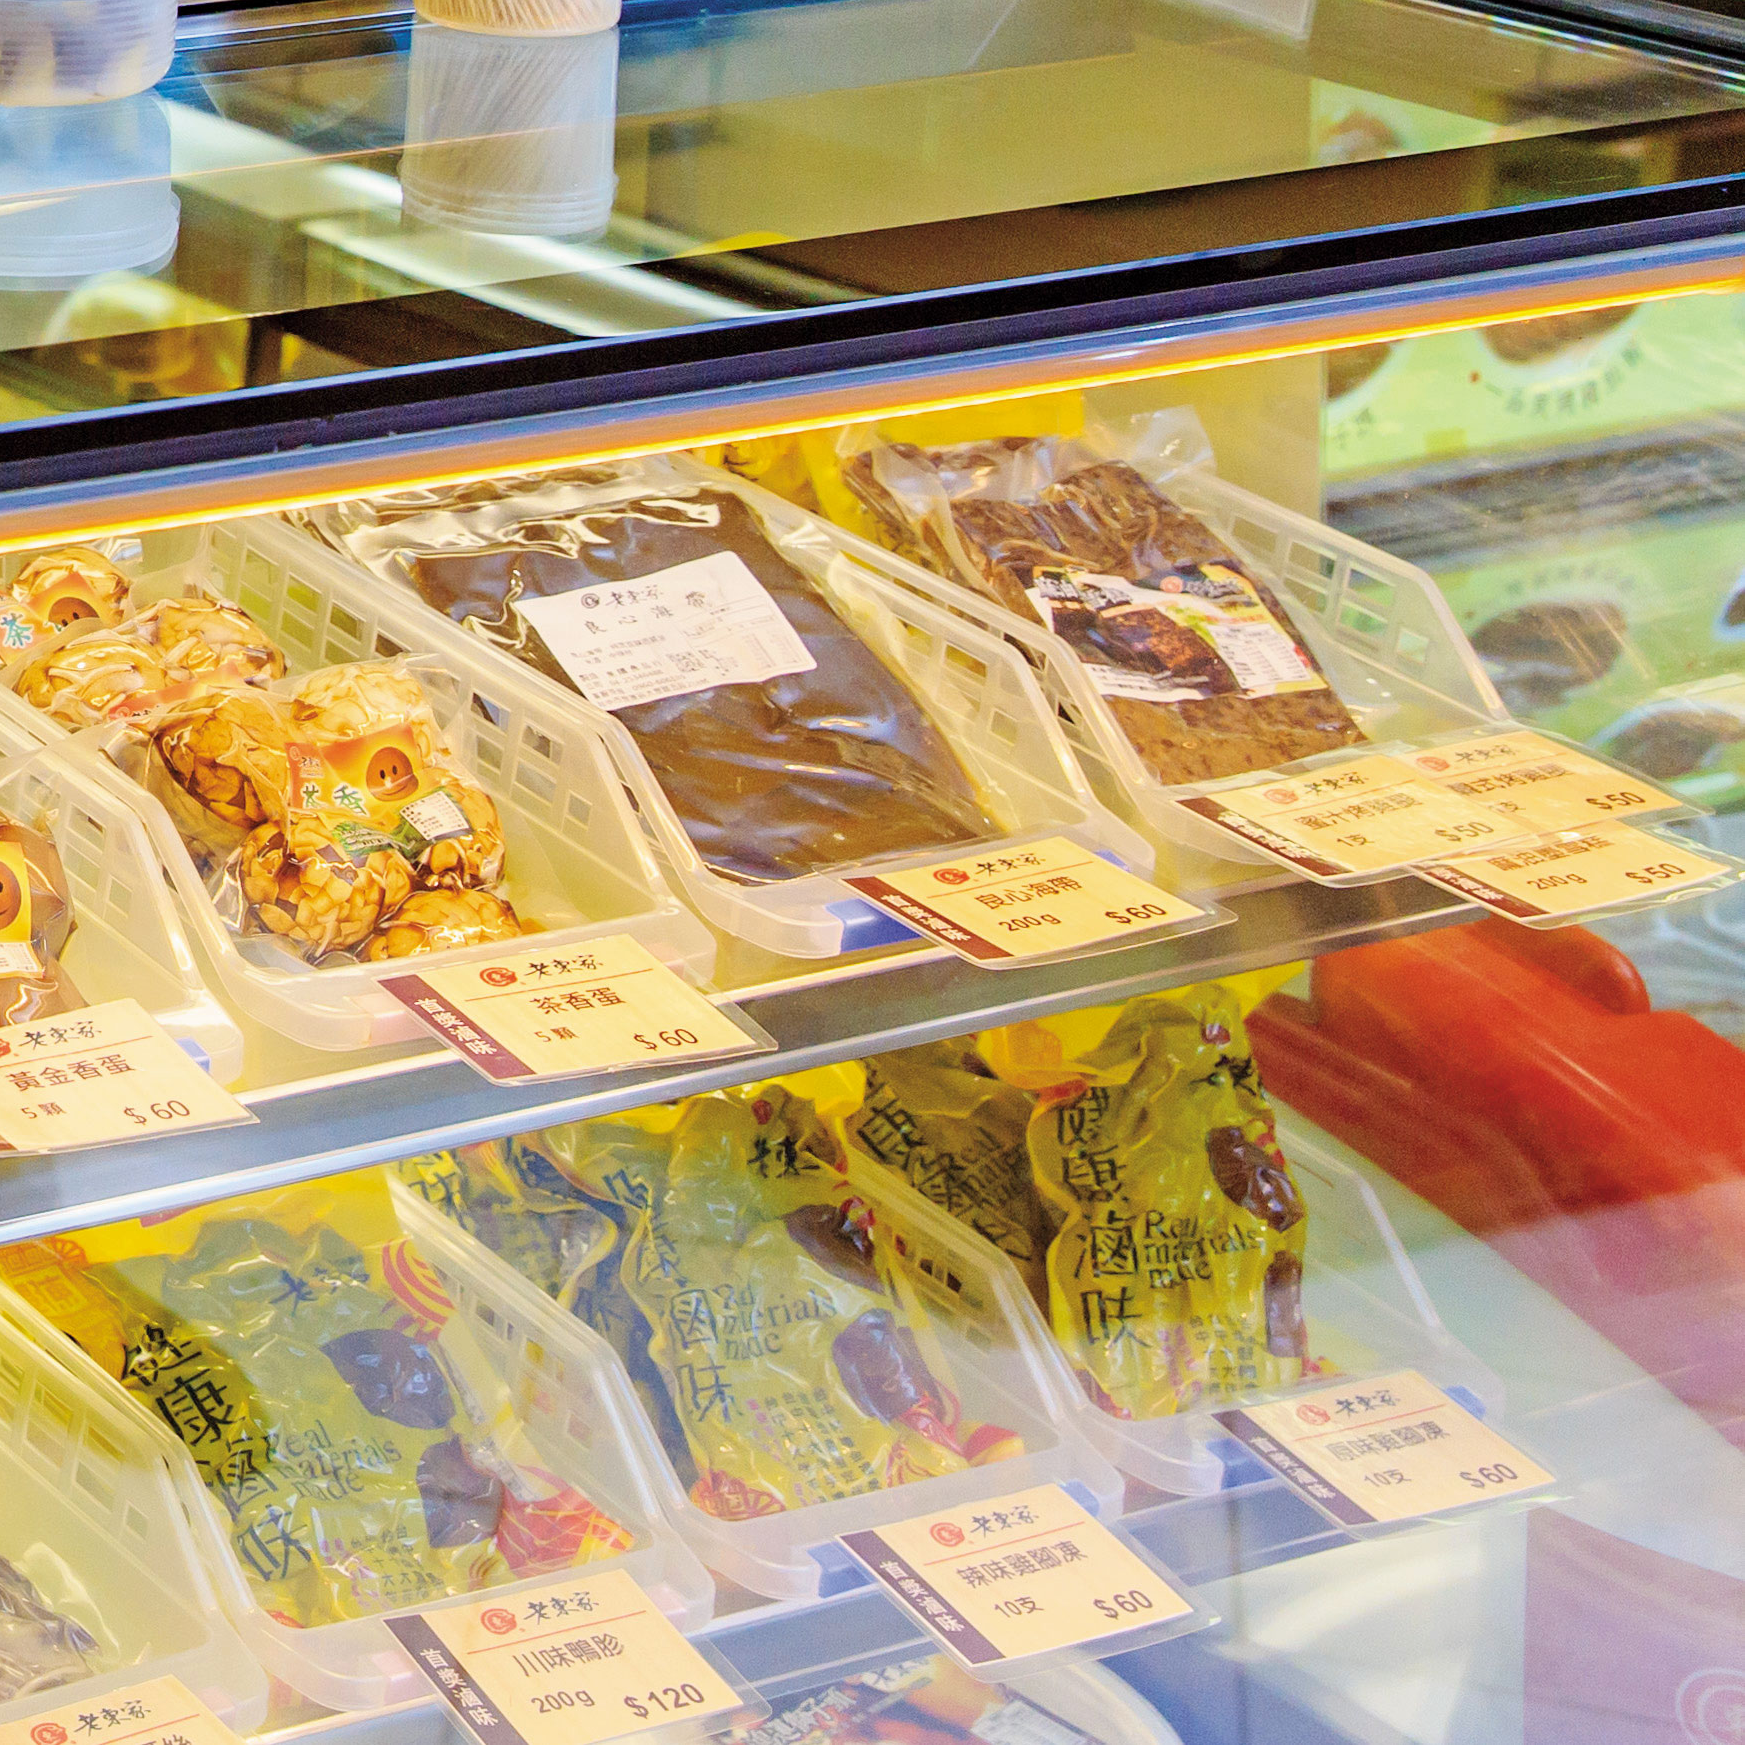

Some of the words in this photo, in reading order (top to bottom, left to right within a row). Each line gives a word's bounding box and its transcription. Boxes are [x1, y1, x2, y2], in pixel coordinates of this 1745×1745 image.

[974, 876, 1083, 910] 良心海帶
[1105, 904, 1167, 925] $60
[530, 987, 626, 1015] 茶香蛋
[634, 1028, 699, 1051] $60
[6, 1054, 136, 1092] 黃金香蛋
[123, 1100, 191, 1126] $60
[1093, 1590, 1153, 1620] $60
